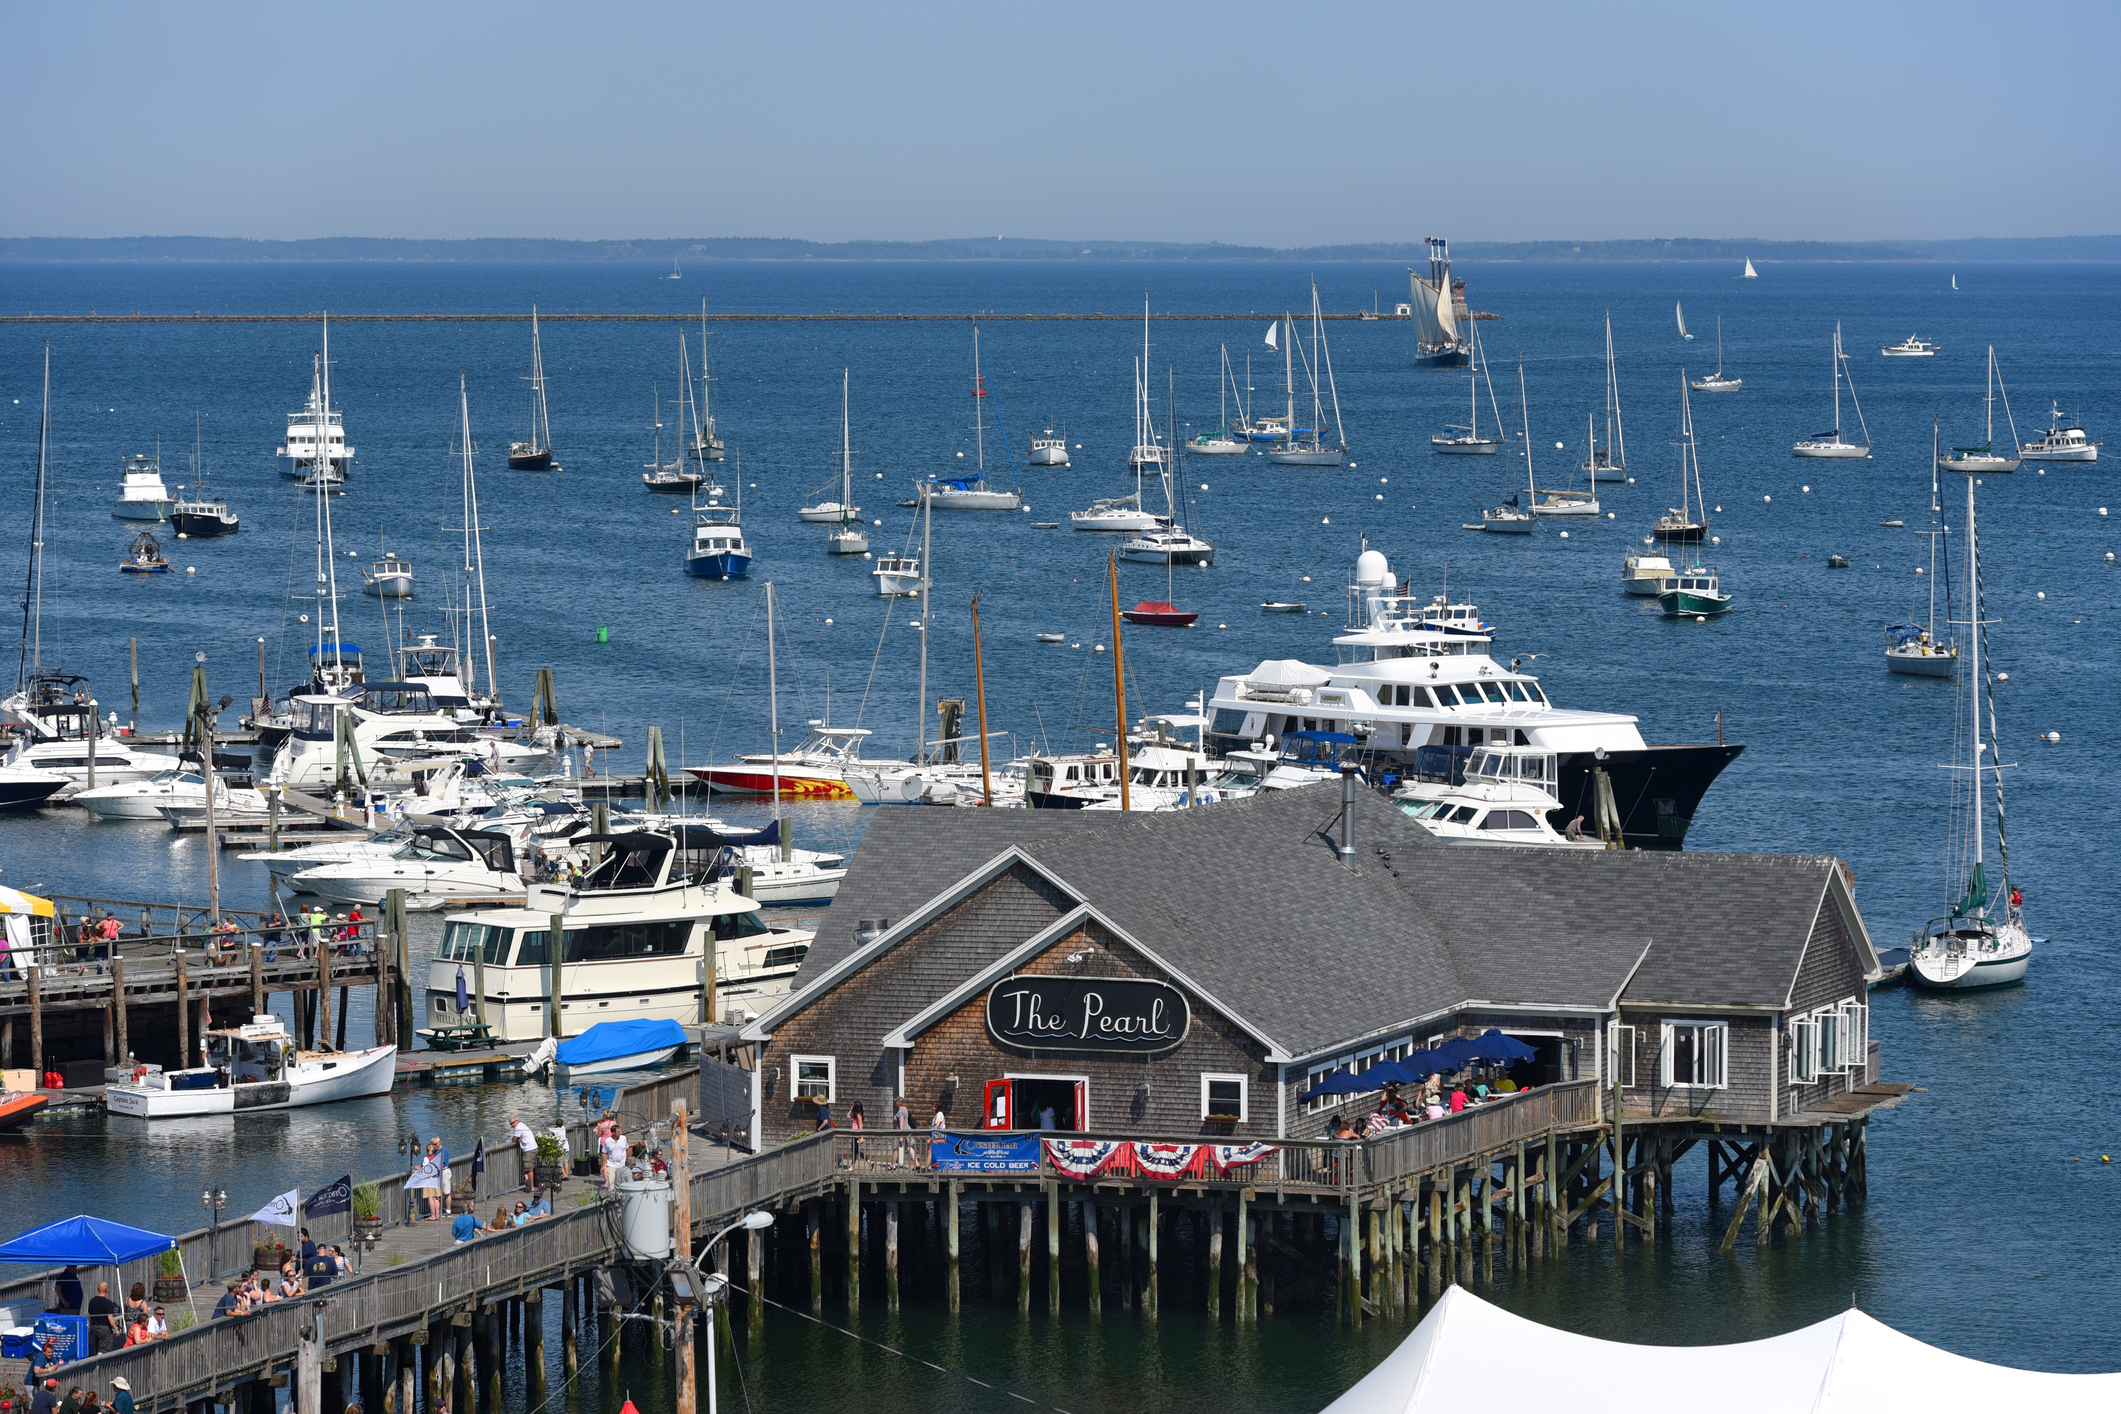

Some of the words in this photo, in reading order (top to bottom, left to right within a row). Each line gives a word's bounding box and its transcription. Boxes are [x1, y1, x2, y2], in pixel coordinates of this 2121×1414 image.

[436, 1012, 456, 1025] STELLA
[1002, 990, 1067, 1030] The
[1079, 992, 1171, 1040] Pearl
[113, 1095, 129, 1104] Captain
[129, 1096, 139, 1106] Jack
[965, 1138, 1001, 1151] OYSTER
